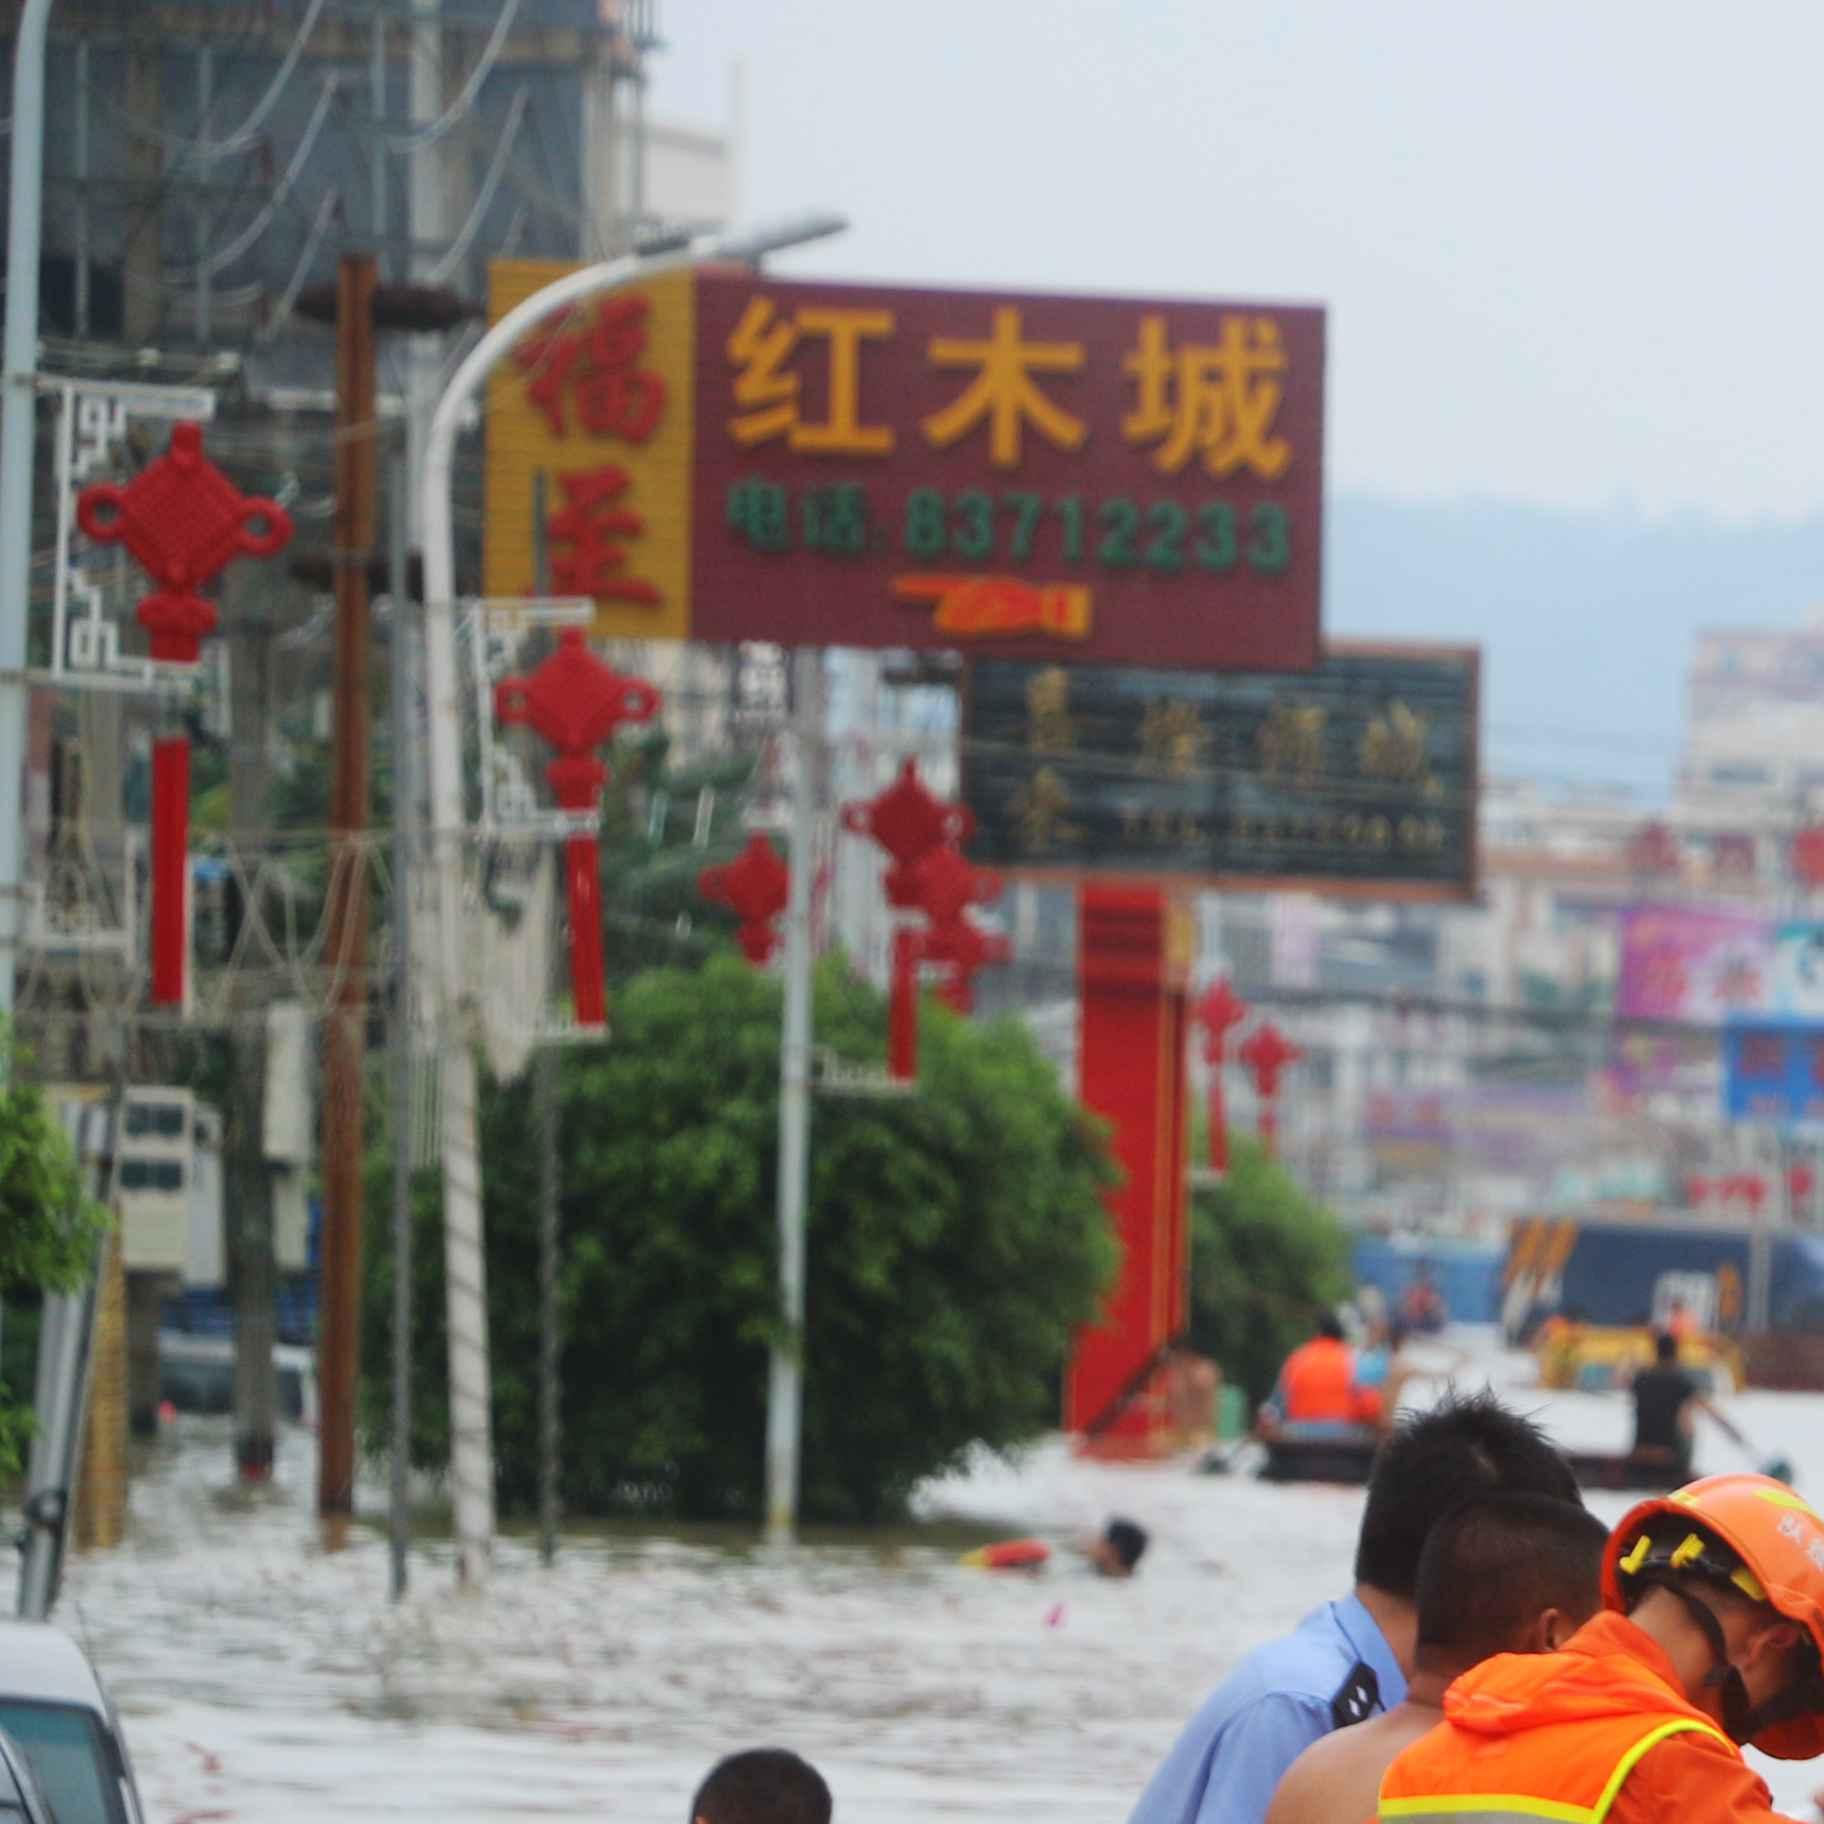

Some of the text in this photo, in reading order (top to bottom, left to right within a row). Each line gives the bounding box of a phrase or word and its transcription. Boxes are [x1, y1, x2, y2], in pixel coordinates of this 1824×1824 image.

[726, 296, 1292, 480] 红木城
[902, 486, 1290, 574] 83712233
